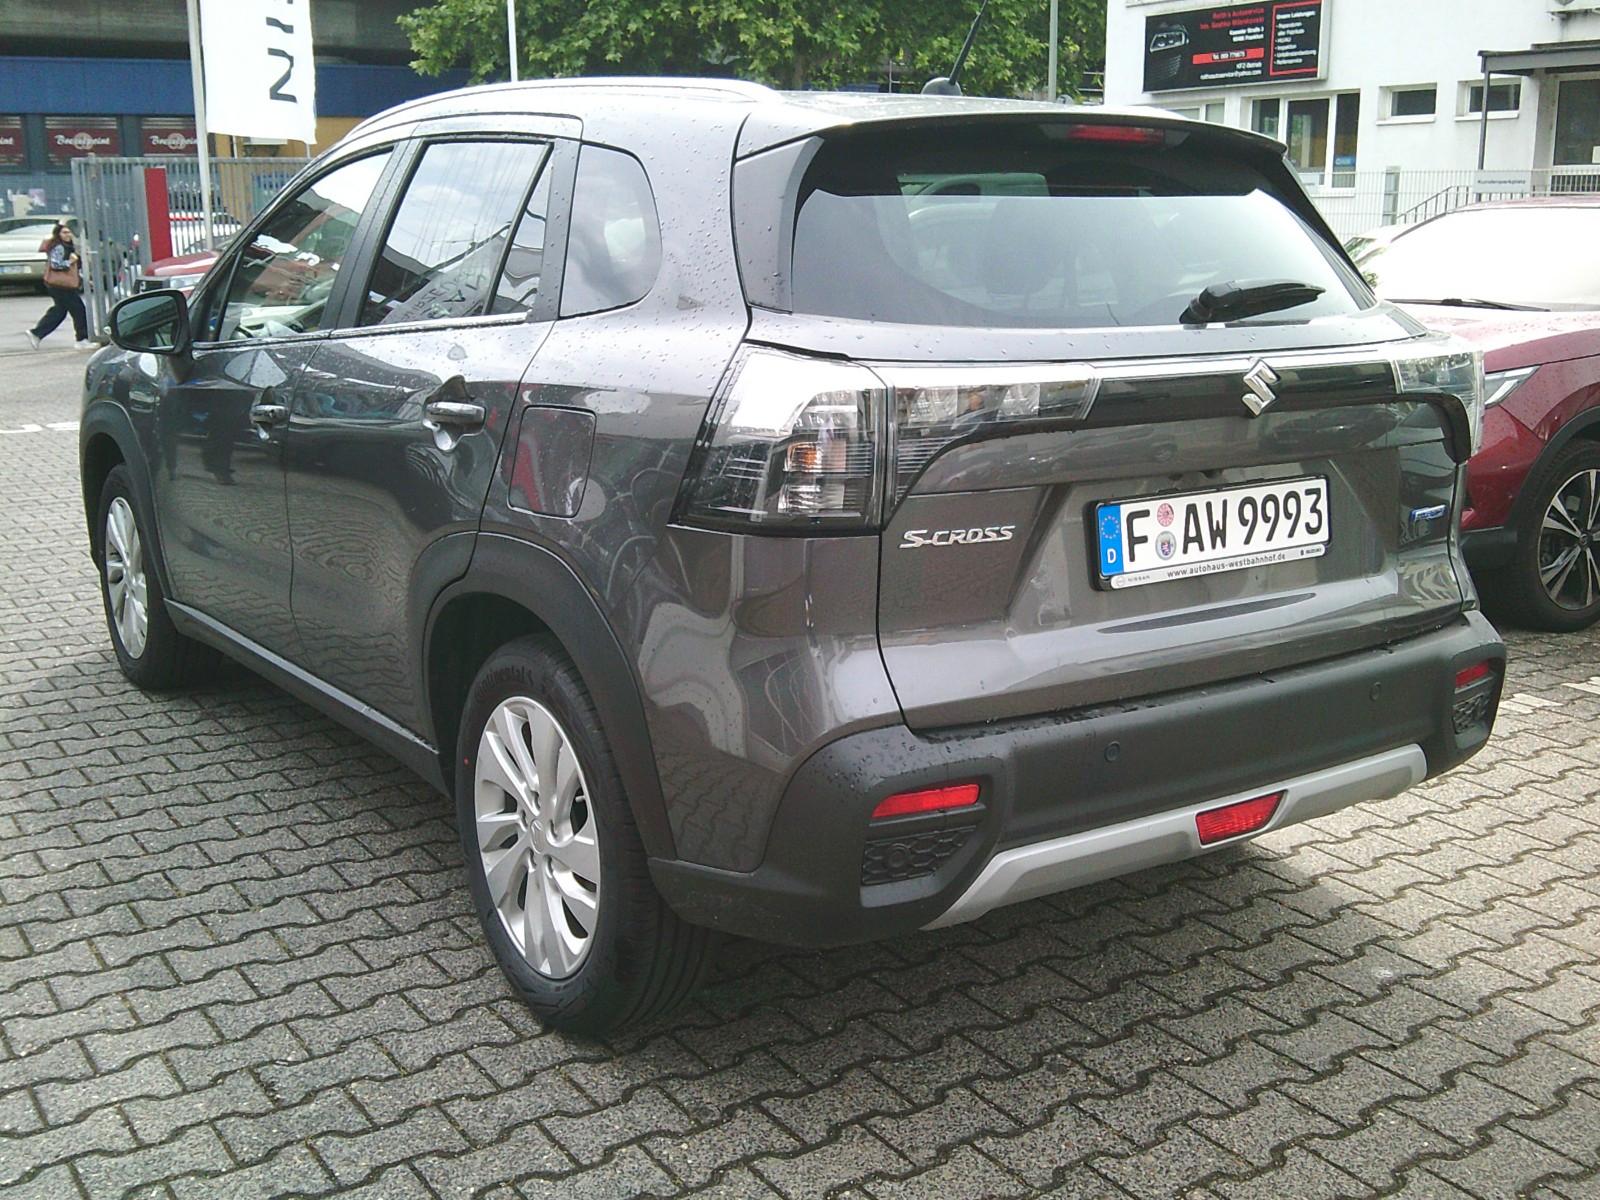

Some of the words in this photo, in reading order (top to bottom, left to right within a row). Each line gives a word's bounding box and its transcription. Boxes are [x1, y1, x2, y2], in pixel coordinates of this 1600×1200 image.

[266, 0, 298, 104] NI
[1125, 509, 1151, 563] F
[1182, 498, 1228, 555] AW
[1238, 487, 1323, 546] 9993
[1107, 548, 1117, 564] D
[1167, 553, 1286, 578] www.autohaus-westbahnhof.de
